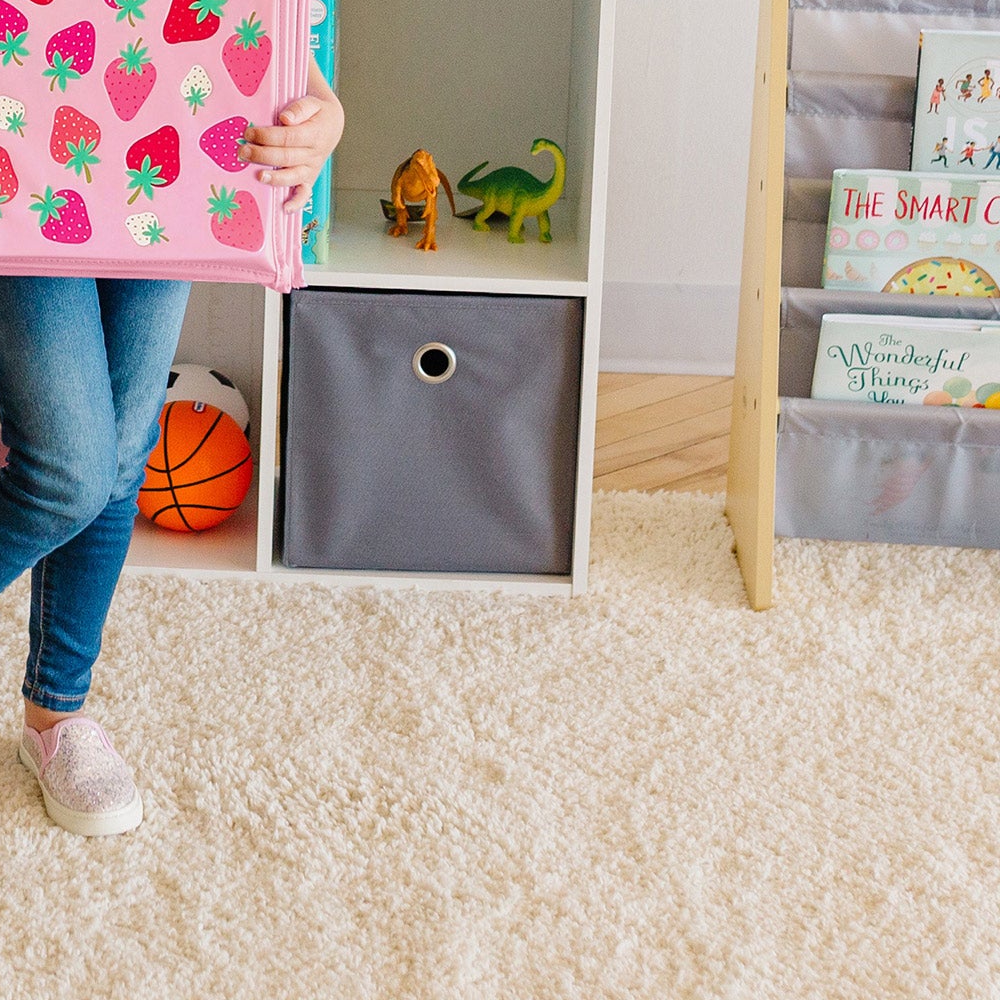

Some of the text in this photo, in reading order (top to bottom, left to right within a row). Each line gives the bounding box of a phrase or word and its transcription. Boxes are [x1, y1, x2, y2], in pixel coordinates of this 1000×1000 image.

[843, 188, 885, 220] THE
[894, 189, 977, 225] SMART
[879, 333, 902, 346] The
[827, 342, 970, 374] Wonderful
[847, 365, 930, 394] Things
